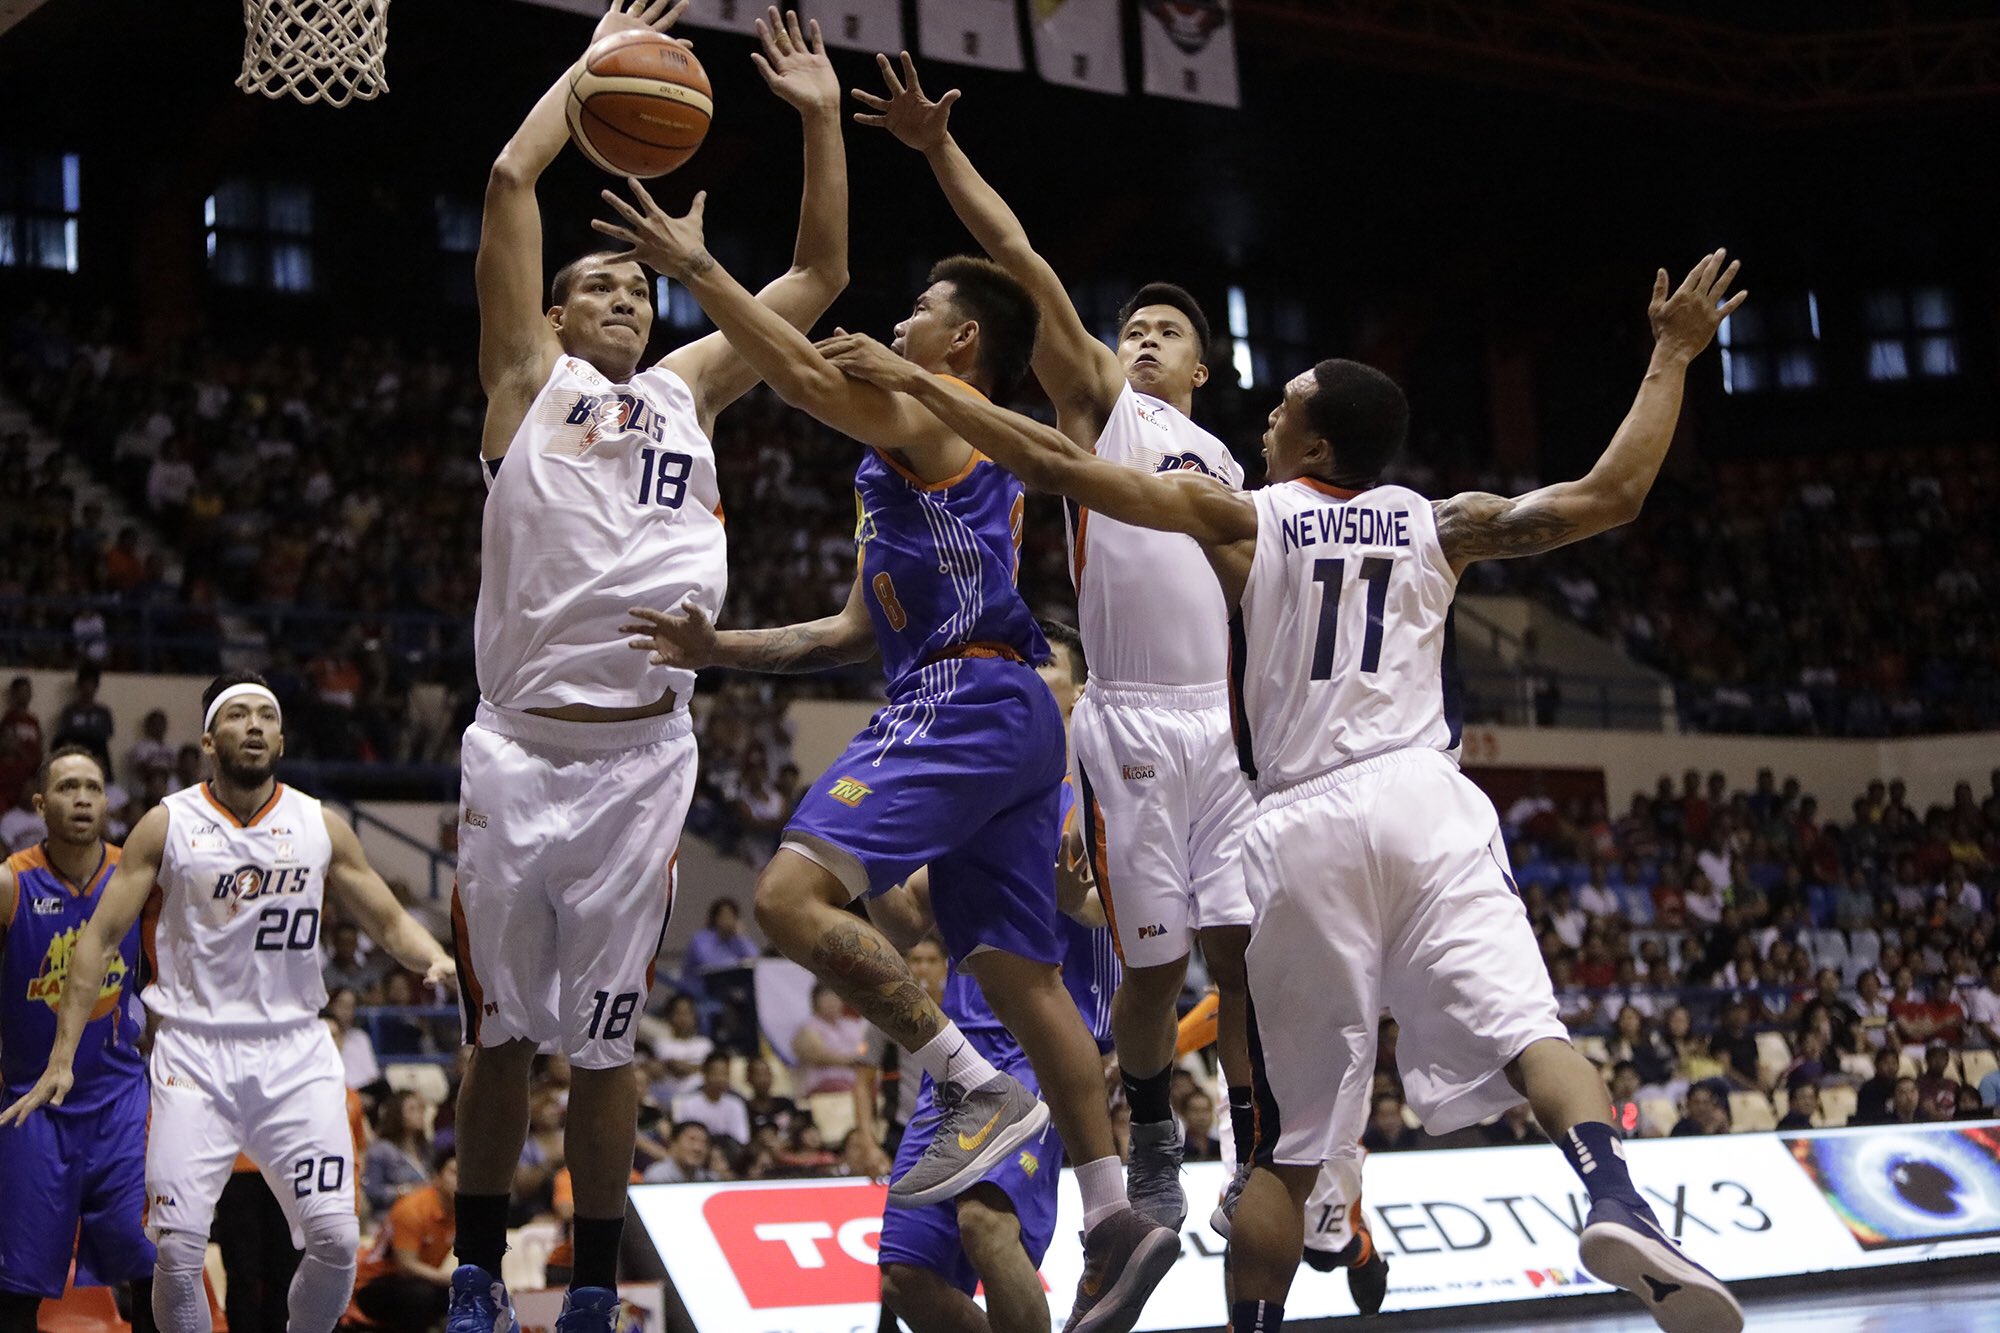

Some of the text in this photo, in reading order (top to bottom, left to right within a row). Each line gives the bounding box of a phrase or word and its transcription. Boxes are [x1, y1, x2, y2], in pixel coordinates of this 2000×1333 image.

[638, 448, 693, 510] 18
[1281, 506, 1411, 555] NEWSOME
[872, 571, 907, 632] 8
[1310, 556, 1395, 681] 11
[828, 778, 874, 802] TNT
[212, 864, 310, 901] BOLTS
[254, 907, 320, 951] 20
[1138, 923, 1168, 939] PBA
[587, 990, 640, 1040] 18
[294, 1155, 345, 1200] 20
[1316, 1204, 1346, 1234] 12
[752, 1216, 884, 1269] TC
[1524, 1268, 1593, 1289] PBA
